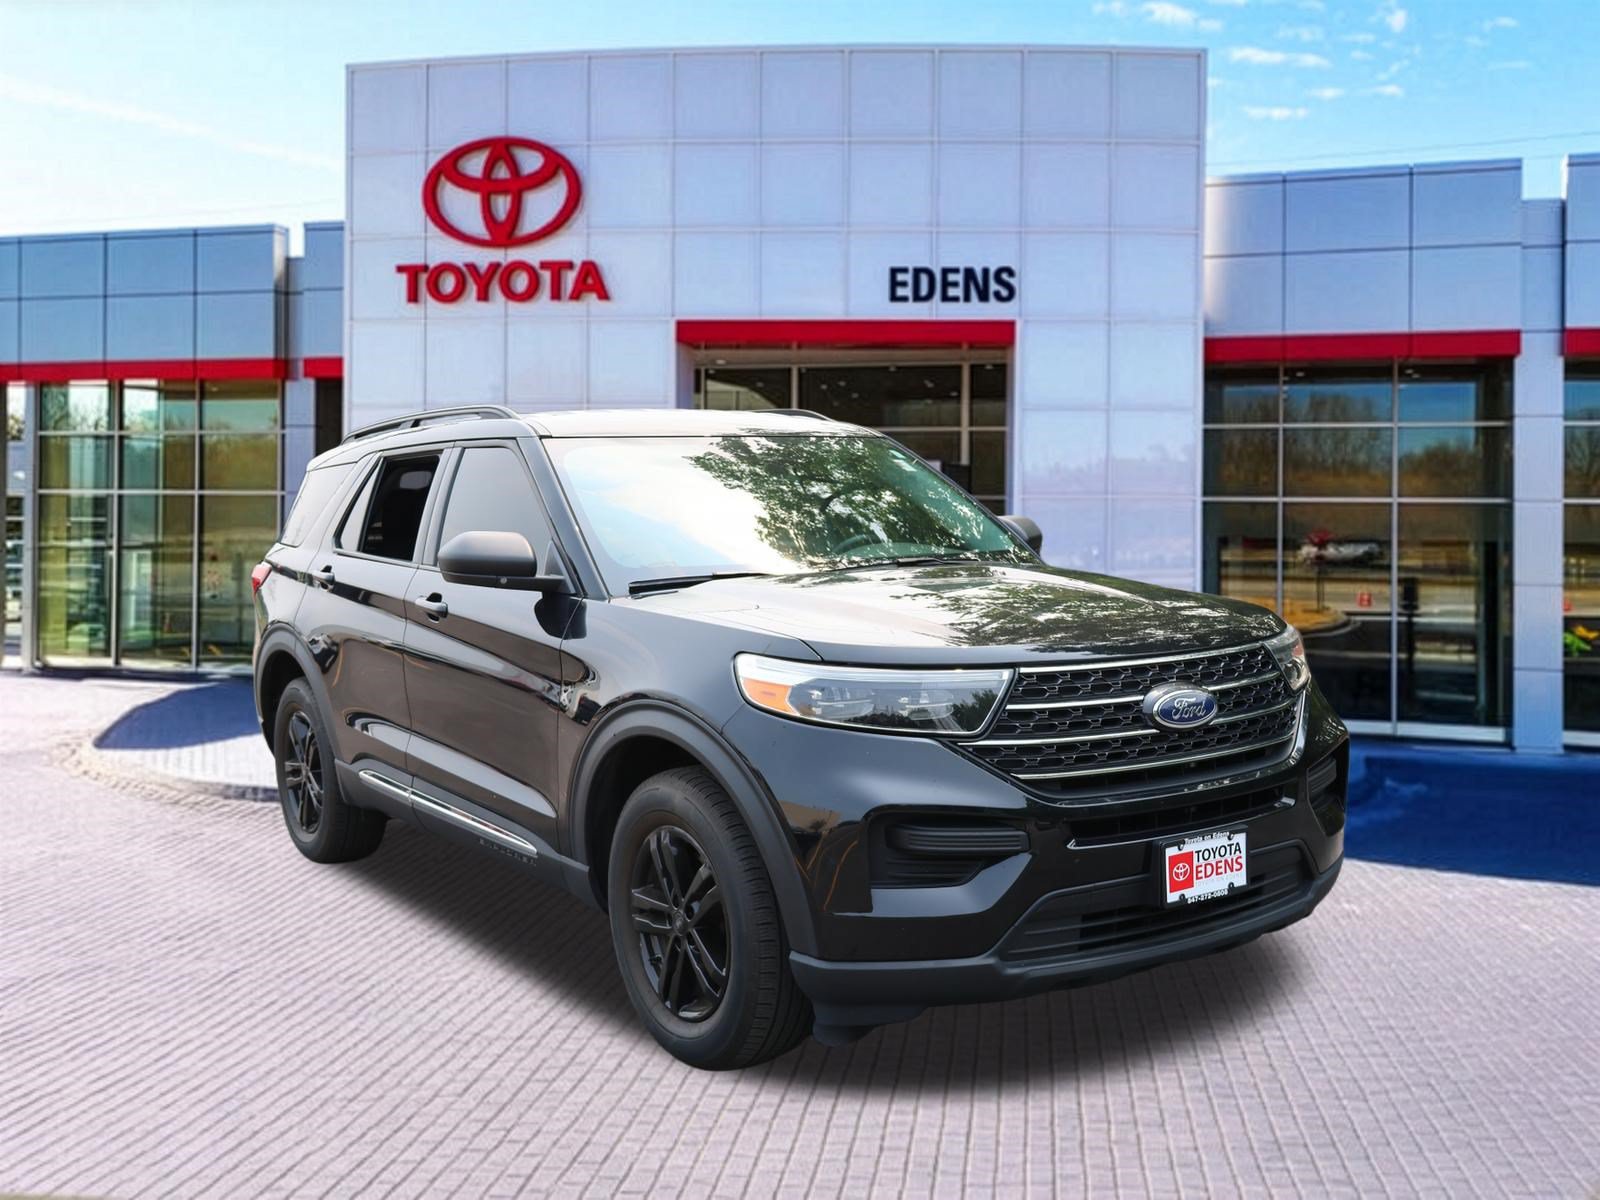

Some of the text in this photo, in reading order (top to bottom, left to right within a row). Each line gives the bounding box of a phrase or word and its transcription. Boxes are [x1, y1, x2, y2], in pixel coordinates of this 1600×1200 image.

[396, 260, 610, 304] TOYOTA
[889, 266, 1016, 303] EDENS
[1172, 697, 1207, 720] Ford
[1195, 842, 1242, 863] TOYOTA
[1195, 855, 1243, 880] EDENS
